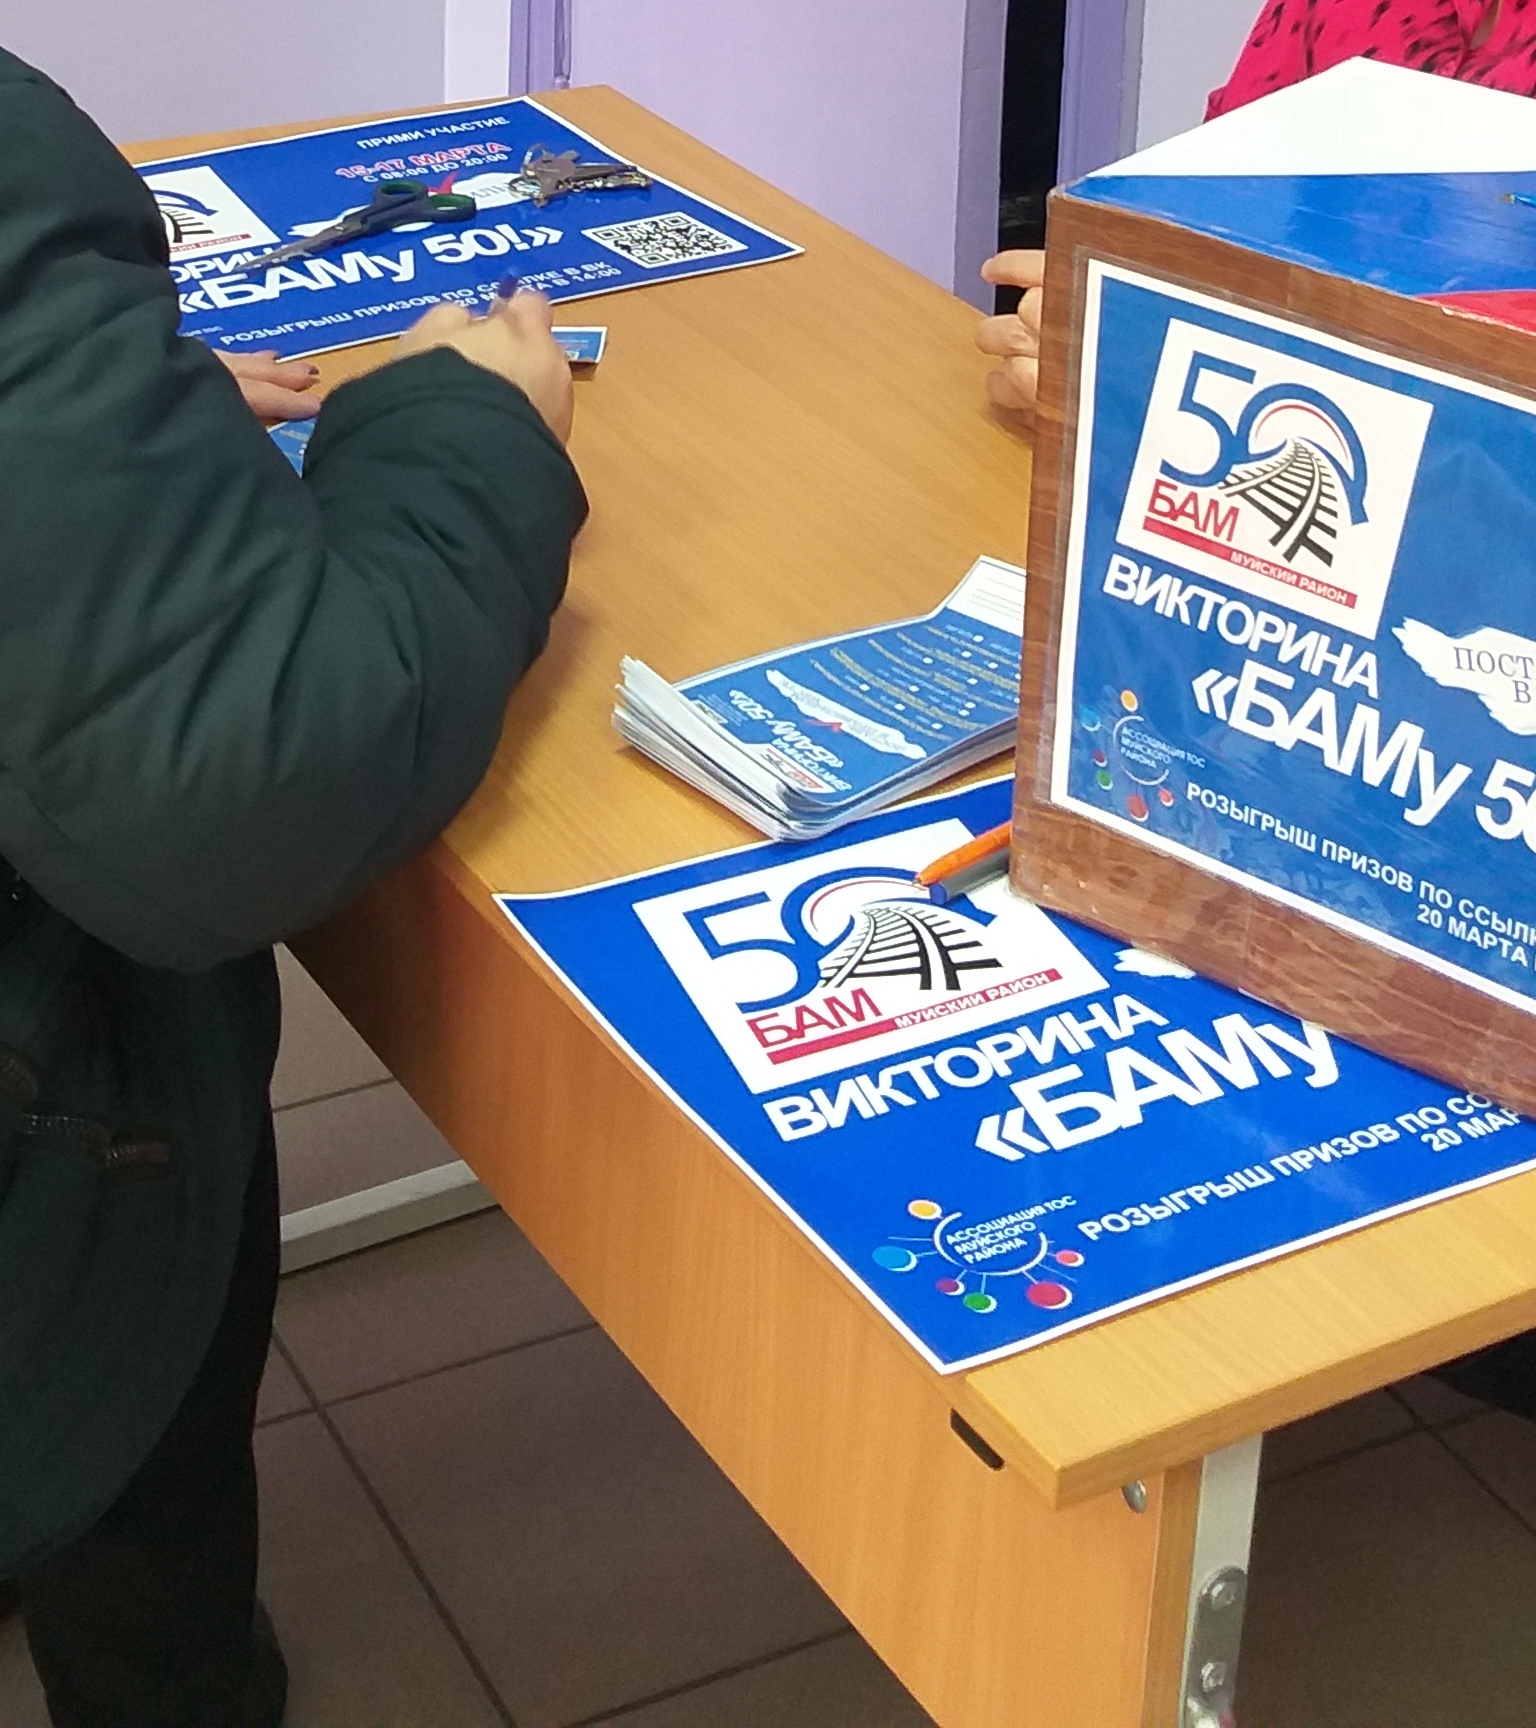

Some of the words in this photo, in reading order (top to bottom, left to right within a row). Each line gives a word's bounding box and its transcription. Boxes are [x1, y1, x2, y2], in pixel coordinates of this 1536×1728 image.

[356, 130, 425, 149] ПРИМИ
[423, 116, 511, 138] УЧАСТИЕ
[408, 141, 513, 166] МАРТА
[430, 162, 460, 174] ДО
[460, 153, 509, 168] 20:00
[422, 224, 564, 264] 50!»
[572, 268, 622, 282] 14:00
[220, 313, 353, 346] РОЗЫГРЫШ
[353, 294, 441, 319] ПРИЗОВ
[441, 287, 475, 301] ПО
[1147, 478, 1240, 542] БАМ
[1103, 553, 1378, 699] ВИКТОРИНА
[1514, 681, 1532, 704] В
[1191, 659, 1473, 826] «БАМу
[1186, 782, 1317, 853] РОЗЫГРЫШ
[1321, 838, 1414, 893] ПРИЗОВ
[1419, 880, 1453, 909] ПО
[1416, 904, 1443, 928] 20
[1448, 916, 1529, 968] МАРТА
[747, 987, 883, 1048] БАМ
[762, 994, 1170, 1141] ВИКТОРИНА
[974, 1013, 1340, 1162] «БАМу
[1420, 1127, 1463, 1152] 20
[1457, 1107, 1521, 1138] МАР
[1077, 1164, 1276, 1242] РОЗЫГРЫШ
[1269, 1123, 1401, 1177] ПРИЗОВ
[1395, 1106, 1447, 1133] ПО
[946, 1204, 1046, 1245] АССОЦИАЦИЯ
[1044, 1195, 1077, 1212] ТОС
